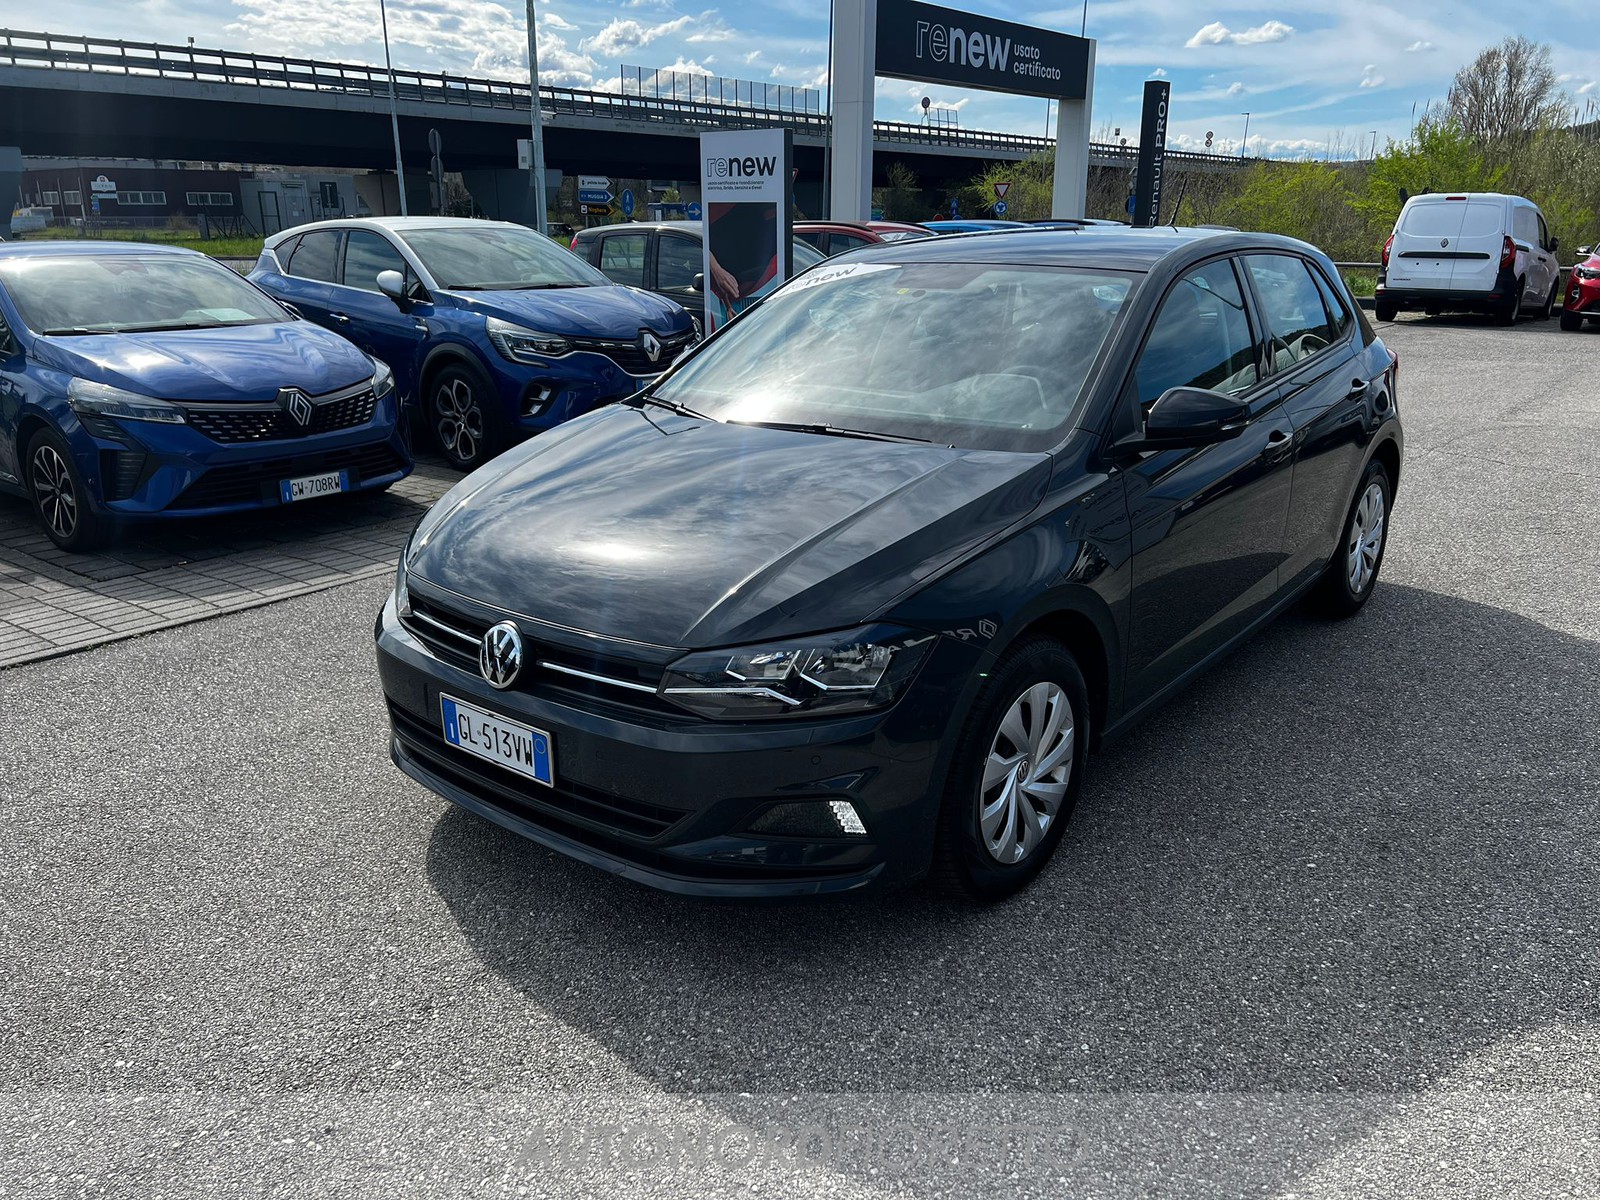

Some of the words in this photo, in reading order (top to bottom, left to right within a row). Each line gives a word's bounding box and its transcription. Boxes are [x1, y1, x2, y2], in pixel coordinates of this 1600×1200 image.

[915, 20, 1011, 72] renew
[1013, 43, 1040, 60] usato
[1013, 61, 1061, 80] certificato
[1154, 88, 1167, 148] PRO+
[706, 156, 777, 178] renew
[1148, 153, 1163, 227] Renault
